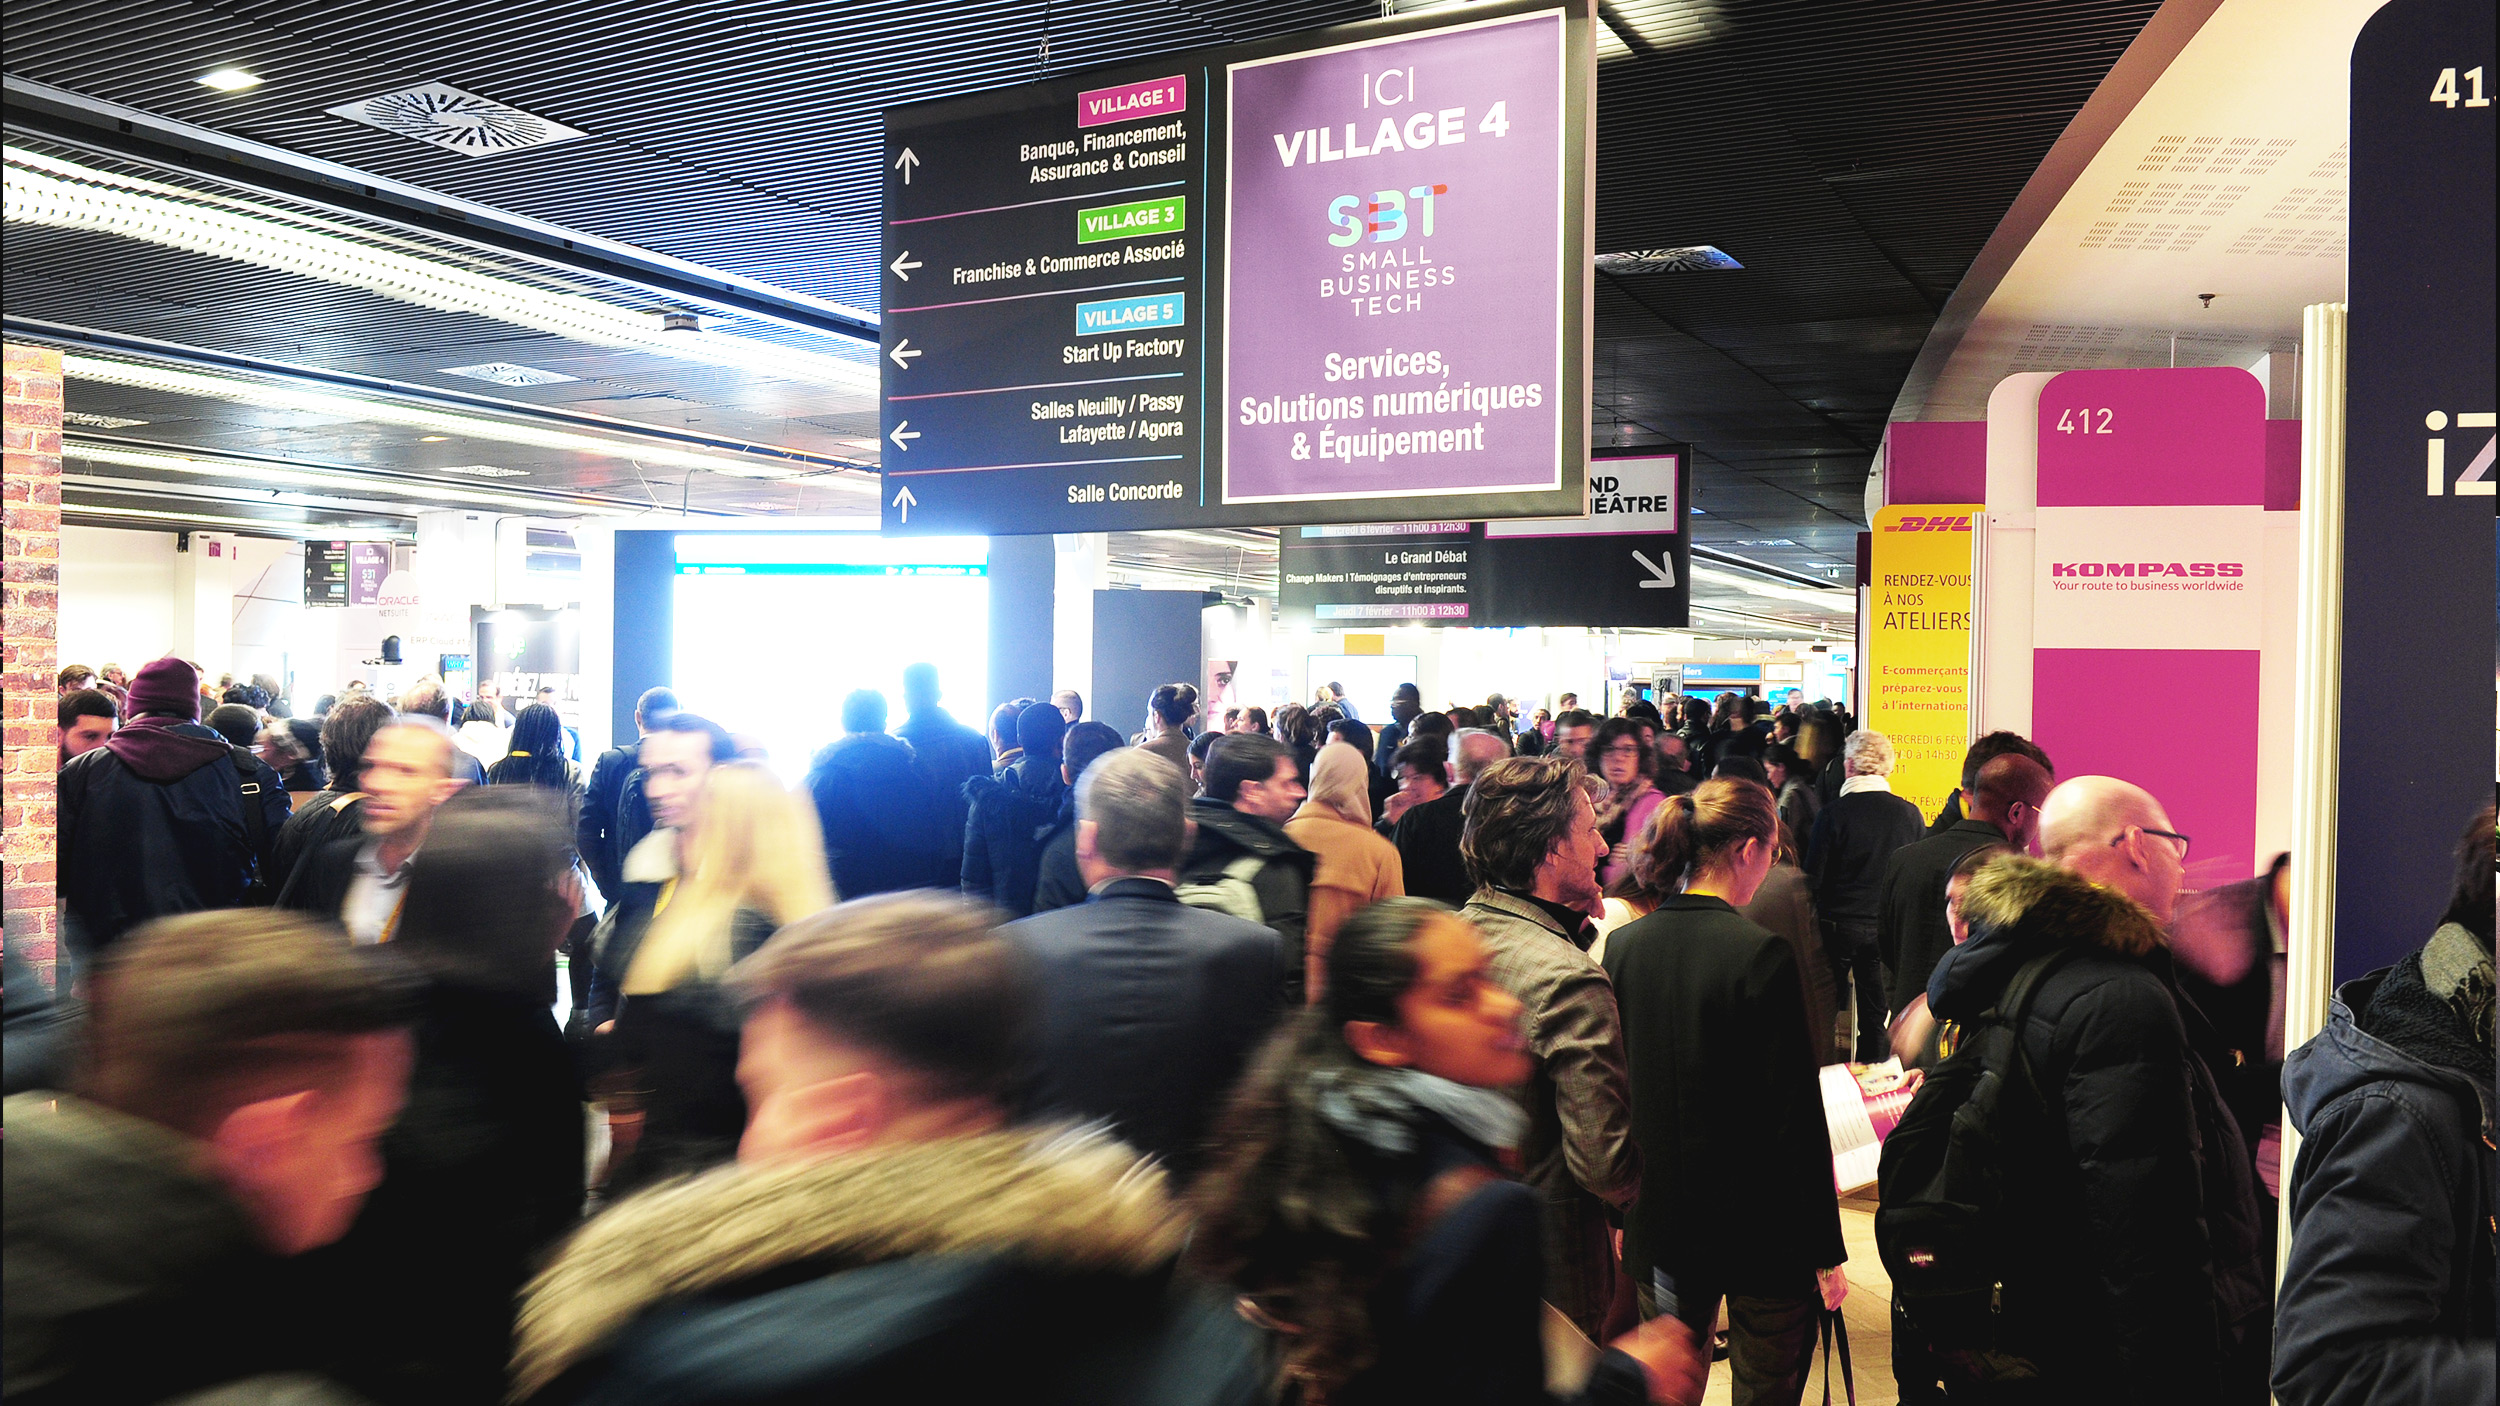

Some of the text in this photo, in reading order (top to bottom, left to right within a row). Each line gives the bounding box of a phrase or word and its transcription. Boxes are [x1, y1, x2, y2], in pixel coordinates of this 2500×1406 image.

[1363, 66, 1414, 109] ICI
[2429, 65, 2496, 109] 41
[1089, 87, 1175, 116] VILLAGE 1
[1020, 119, 1187, 162] Banque, Financement,
[1273, 100, 1510, 168] VILLAGE 4
[1030, 142, 1186, 184] Assurance & Conseil
[1085, 206, 1175, 233] VILLAGE 3
[1328, 184, 1448, 247] SBT
[953, 238, 1185, 285] Franchise & Commerce Associé
[1342, 246, 1432, 273] SMALL
[1320, 266, 1455, 298] BUSINESS
[1084, 303, 1173, 328] VILLAGE 5
[1351, 292, 1421, 317] TECH
[1063, 339, 1184, 364] Start Up Factory
[1324, 348, 1450, 382] Services,
[1031, 393, 1184, 420] Salles Neuilly / Passy
[1240, 381, 1543, 426] Solutions numériques
[1060, 419, 1183, 445] Lafayette / Agora
[2057, 407, 2114, 435] 412
[1291, 421, 1485, 464] & Équipement
[1067, 480, 1183, 503] Salle Concorde
[1360, 525, 1366, 534] 6
[1403, 524, 1430, 533] 11h00
[1439, 522, 1466, 532] 12h30
[1898, 517, 1973, 532] DHL
[1385, 550, 1467, 565] Le Grand Débat
[2052, 562, 2244, 577] KOMPASS
[1286, 573, 1314, 585] Change
[1315, 573, 1344, 583] Makers
[1350, 572, 1402, 584] Témoignages
[1403, 571, 1467, 582] d'entrepreneurs
[1375, 584, 1467, 596] disruptifs et inspirants.
[1884, 574, 1971, 587] RENDEZ-VOUS
[2053, 580, 2244, 591] Your route to business worldwide
[379, 596, 420, 606] ORACLE
[1333, 606, 1356, 616] Jeudi
[1357, 606, 1363, 616] 7
[1366, 606, 1393, 616] février
[1402, 606, 1428, 616] 11h00
[1429, 605, 1436, 616] à
[1438, 605, 1465, 616] 12h30
[1883, 591, 1924, 606] À NOS
[1883, 611, 1970, 630] ATELIERS
[410, 636, 428, 645] ERP
[1882, 665, 1969, 678] E-commerçants
[1882, 682, 1962, 695] préparez-vous
[1882, 700, 1889, 710] à
[1936, 735, 1942, 745] 6
[1926, 749, 1958, 760] 14h30
